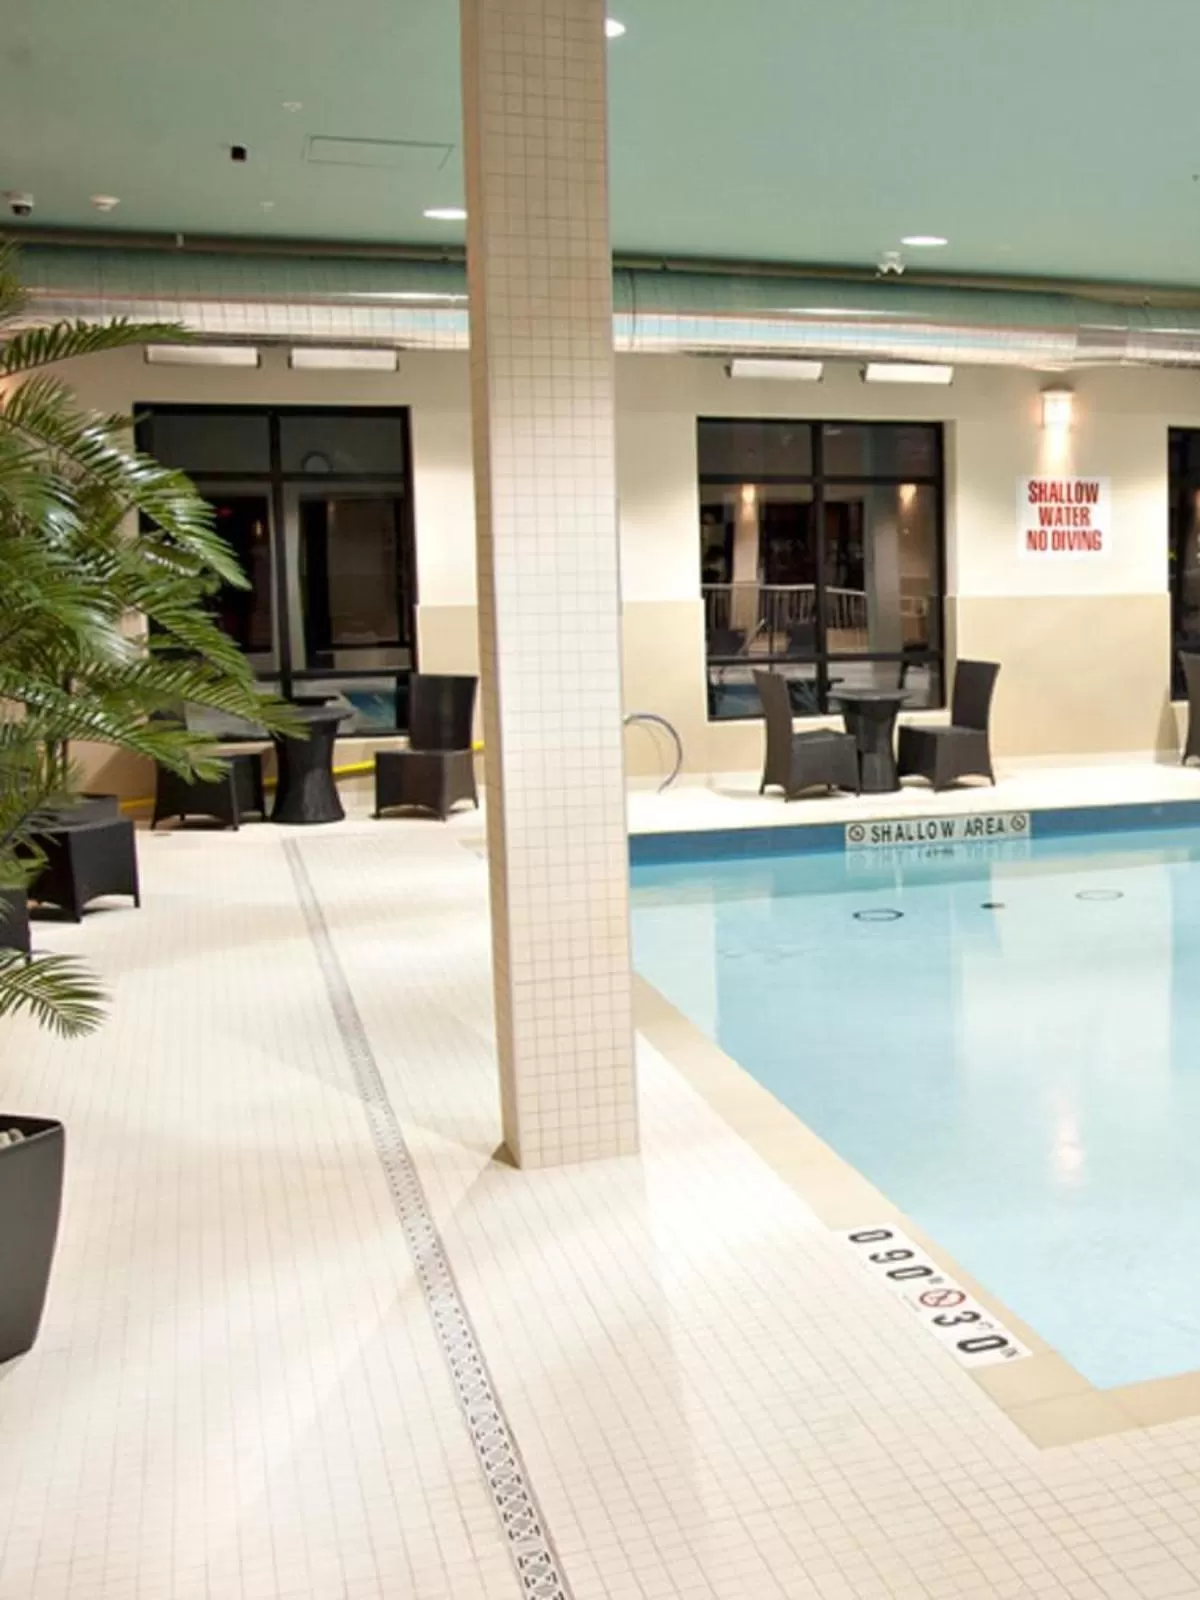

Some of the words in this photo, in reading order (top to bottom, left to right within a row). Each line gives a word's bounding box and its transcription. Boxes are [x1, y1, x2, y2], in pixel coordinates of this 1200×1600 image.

[1028, 480, 1099, 503] SHALLOW
[1039, 506, 1091, 527] WATER
[1026, 530, 1047, 551] NO
[1051, 530, 1103, 551] DIVING
[871, 820, 955, 843] SHALLOW
[964, 817, 1005, 836] AREA
